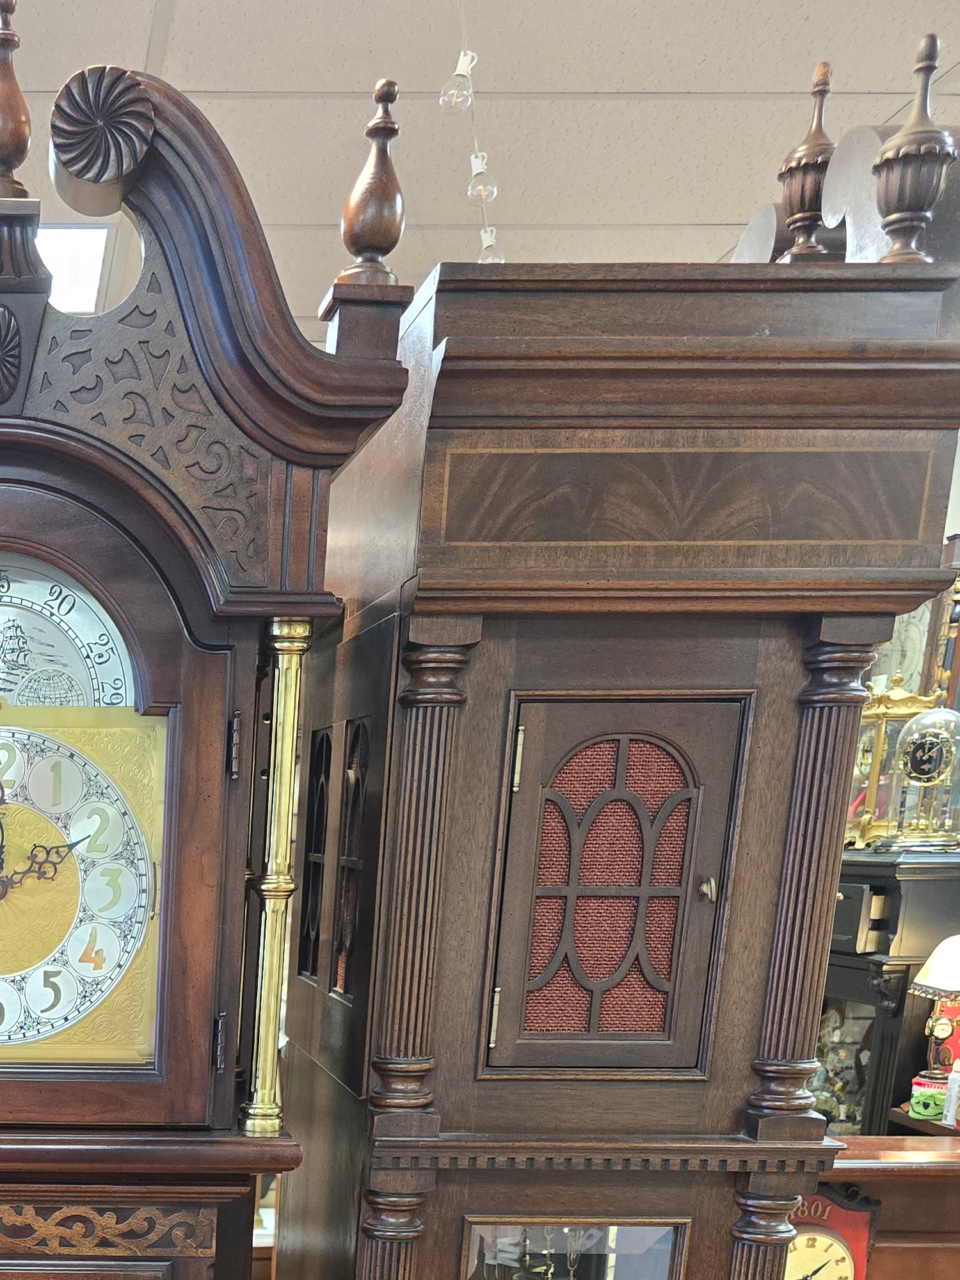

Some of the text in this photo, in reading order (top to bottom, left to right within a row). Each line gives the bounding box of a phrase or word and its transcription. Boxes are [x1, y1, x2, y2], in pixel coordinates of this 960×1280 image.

[43, 584, 76, 617] 20
[86, 633, 116, 665] 25
[101, 678, 124, 706] 29
[50, 760, 62, 806] 1
[87, 806, 111, 853] 2
[99, 867, 122, 913] 3
[78, 927, 107, 971] 4
[40, 970, 63, 1013] 5
[806, 1237, 817, 1248] 12
[823, 1243, 834, 1253] 1
